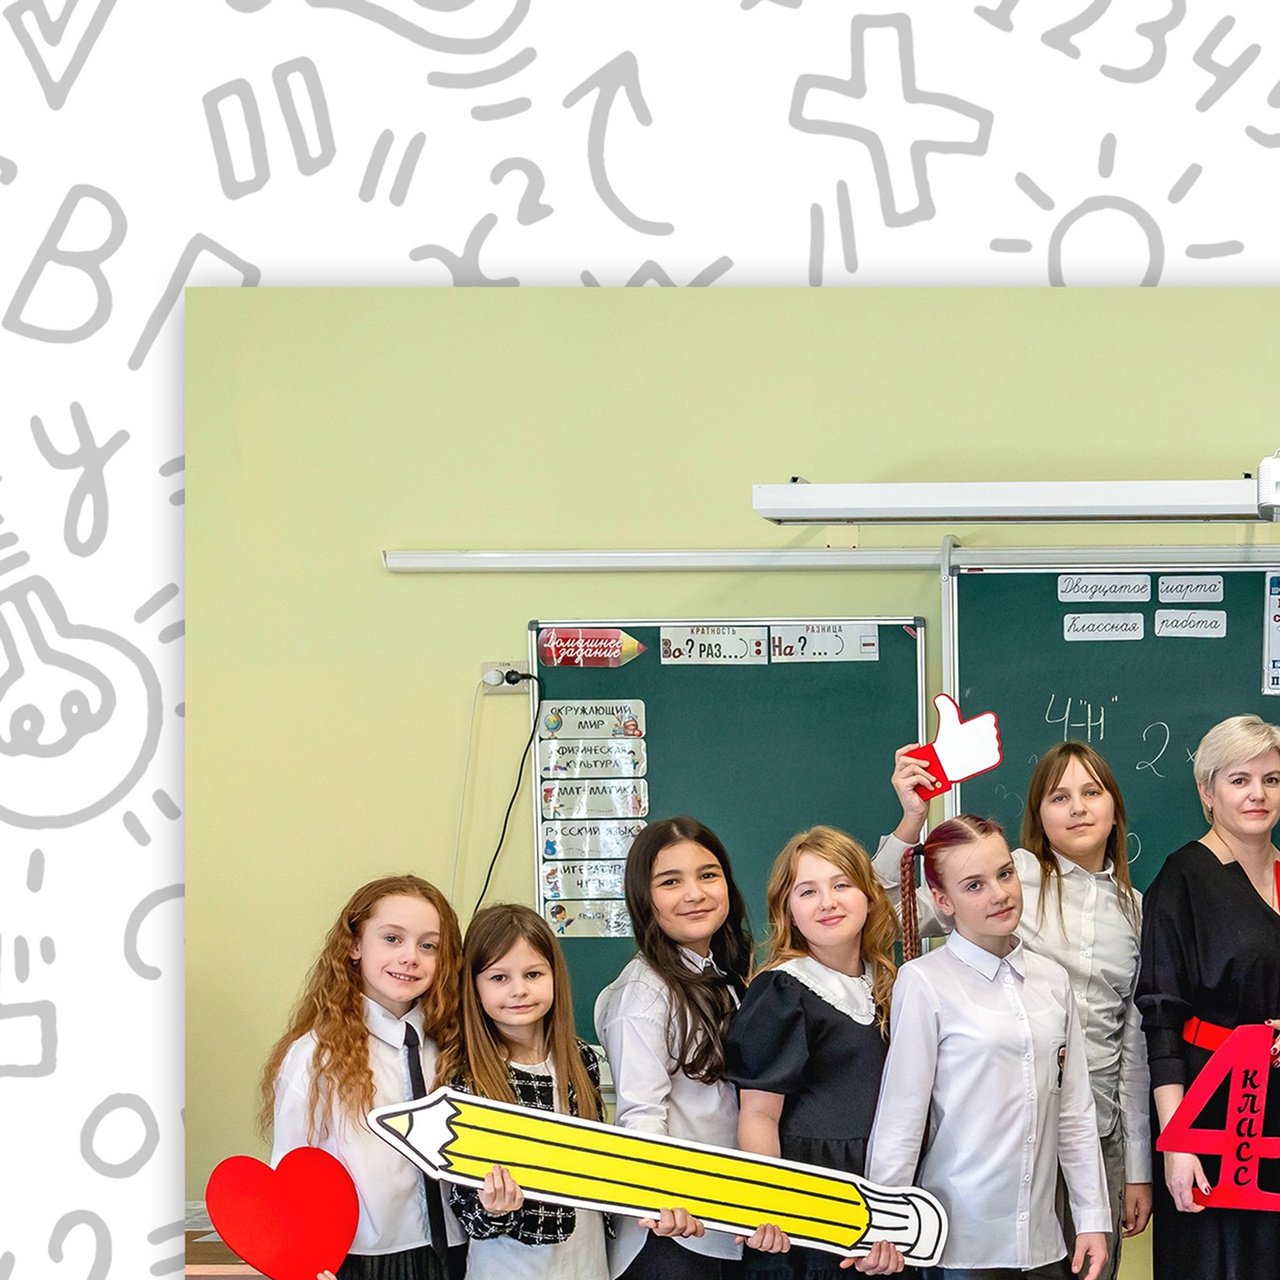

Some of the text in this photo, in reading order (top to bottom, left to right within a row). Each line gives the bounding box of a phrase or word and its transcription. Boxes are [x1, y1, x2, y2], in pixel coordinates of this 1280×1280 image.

[1060, 576, 1148, 600] Двадцатое
[805, 625, 843, 634] РАЗНИЦА
[1067, 612, 1221, 635] Классная работа
[690, 627, 737, 636] КРАТНОСТЬ
[543, 631, 623, 649] Домашнее
[557, 647, 621, 664] задание
[550, 705, 632, 717] ОКРУЖАЮЩИЙ
[577, 720, 605, 730] МИР
